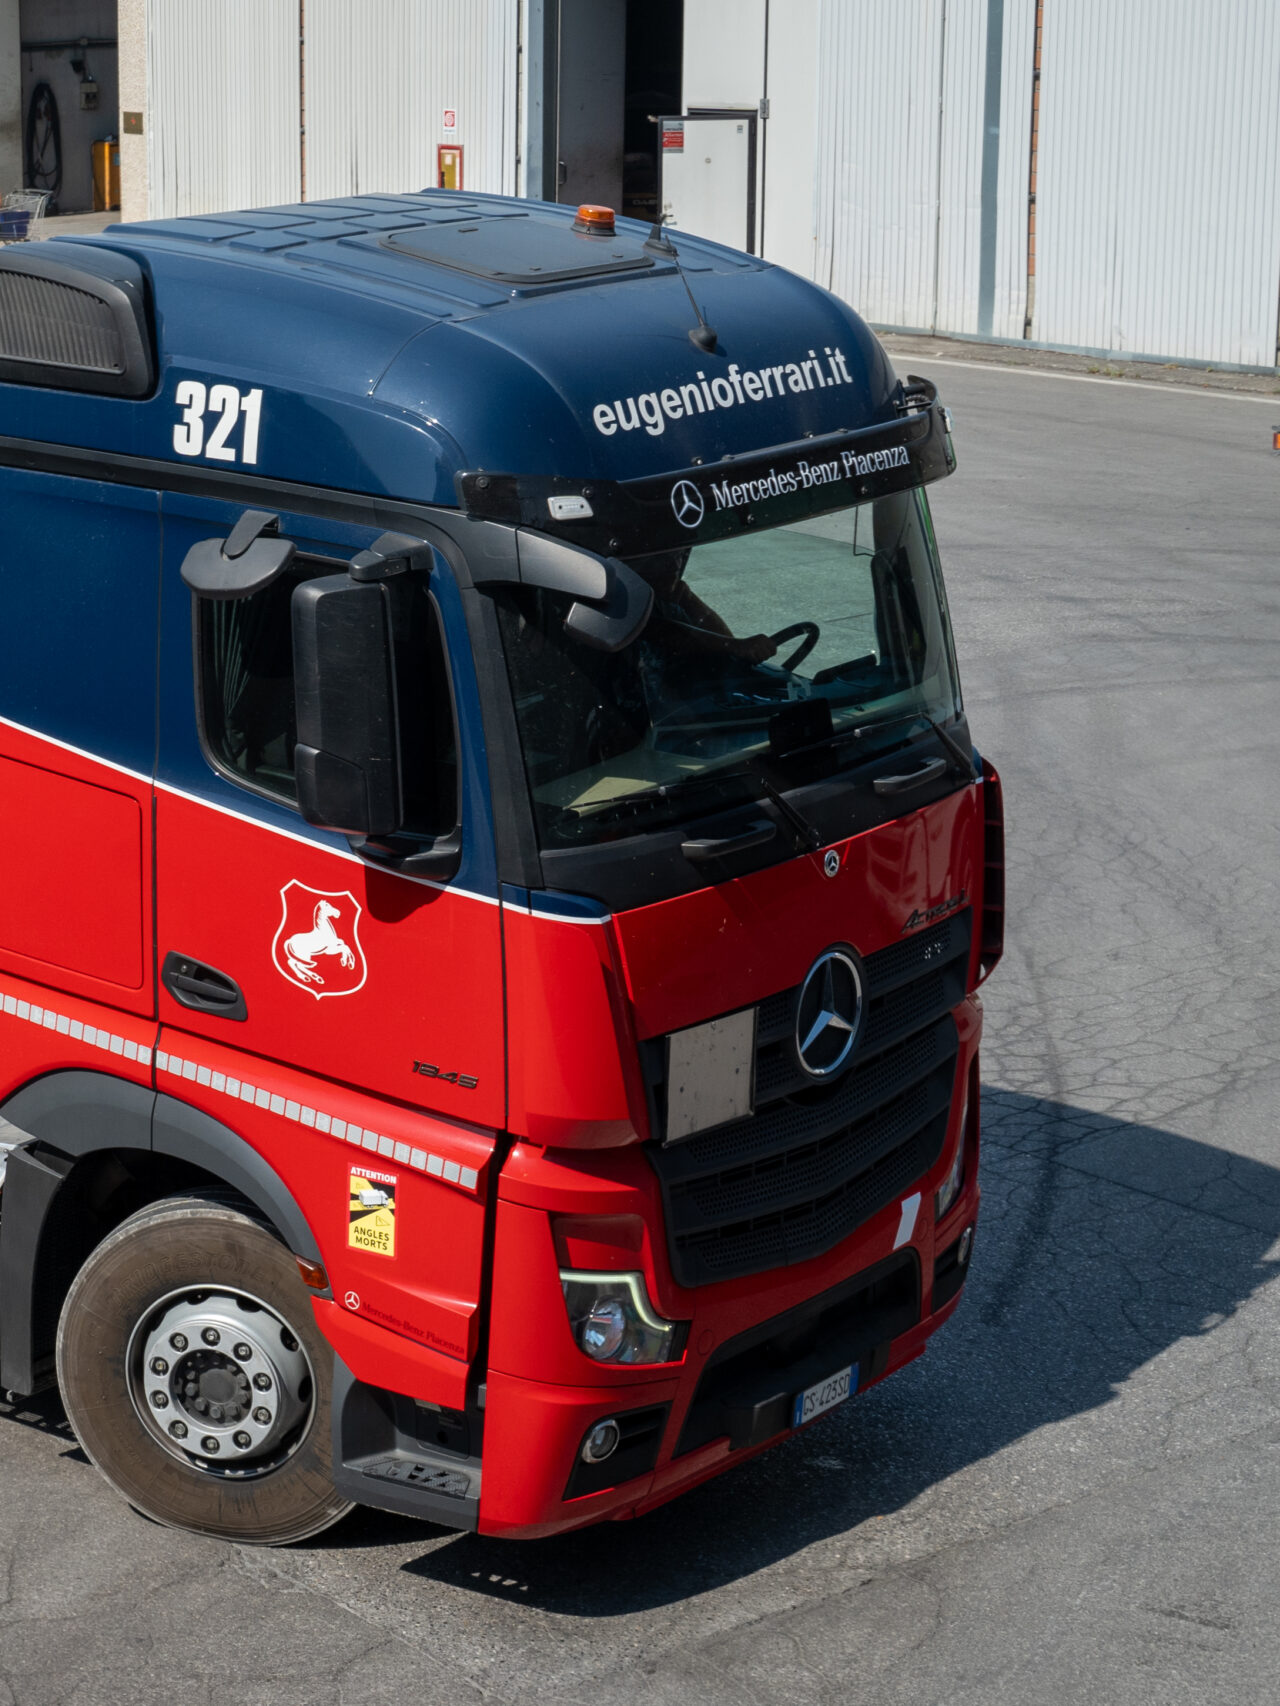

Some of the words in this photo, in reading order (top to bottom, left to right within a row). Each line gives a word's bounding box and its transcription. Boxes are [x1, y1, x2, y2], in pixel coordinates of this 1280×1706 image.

[593, 347, 853, 436] eugenioferrari.it
[173, 380, 263, 465] 321
[710, 461, 841, 511] Mercedes-Benz
[839, 446, 910, 478] Piacenza
[412, 1059, 478, 1089] 1845
[350, 1166, 397, 1184] ATTENTION
[353, 1226, 390, 1241] ANGLES
[355, 1236, 388, 1251] MORTS
[361, 1302, 424, 1338] Mercedes-Benz
[425, 1331, 465, 1354] Piacenza
